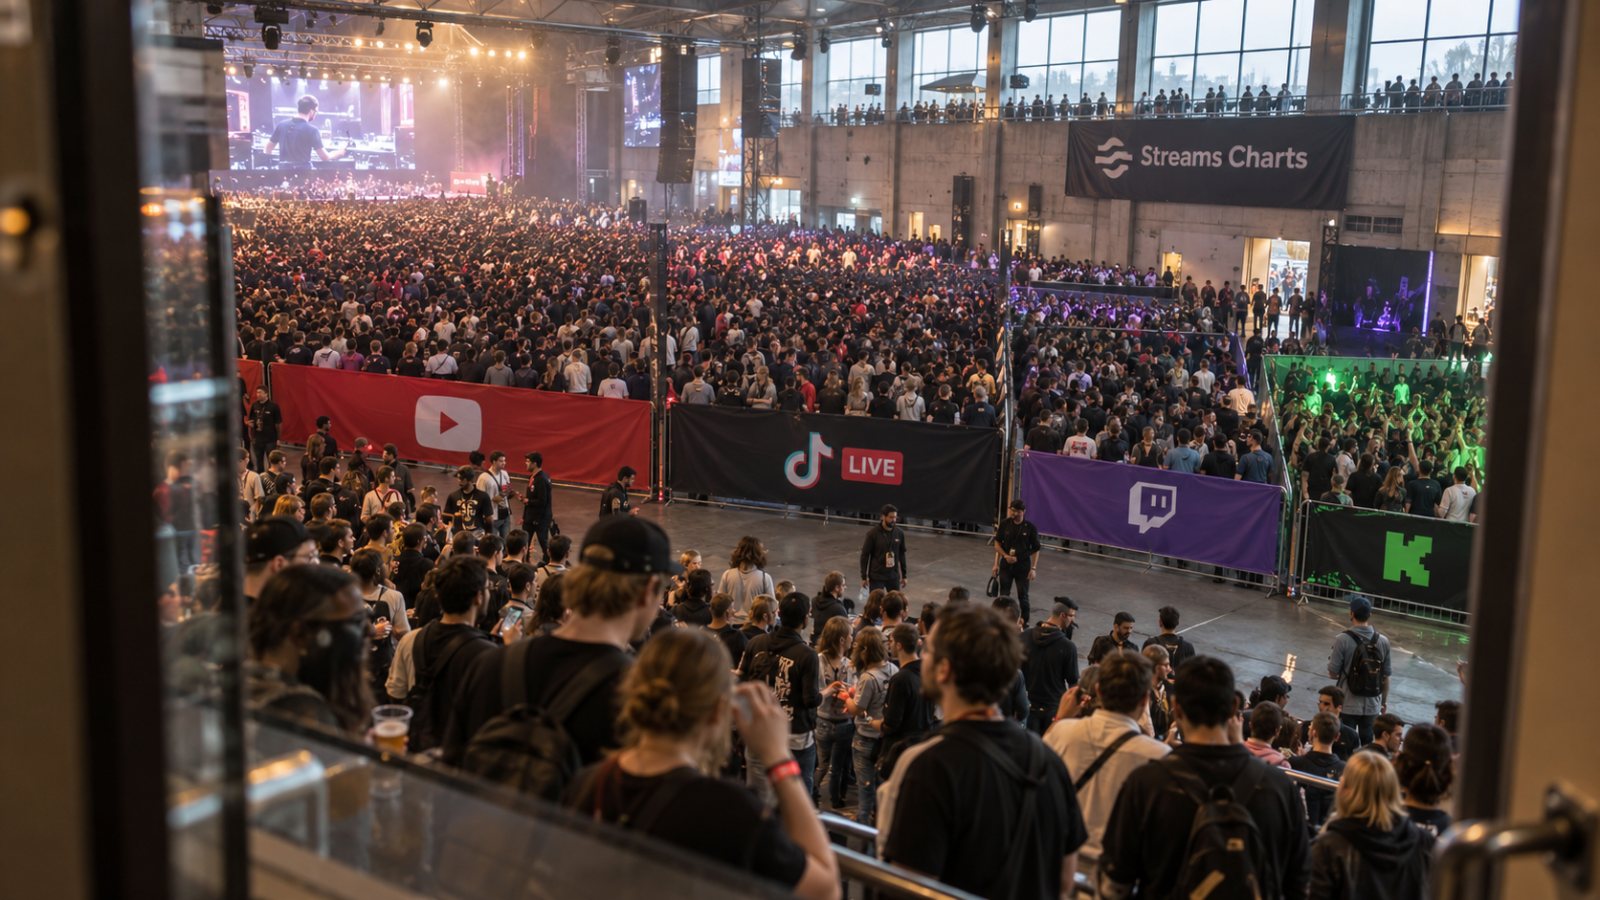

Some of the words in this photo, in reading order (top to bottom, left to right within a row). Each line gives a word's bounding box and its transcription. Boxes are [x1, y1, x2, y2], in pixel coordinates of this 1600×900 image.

[1141, 145, 1222, 167] Streams
[1228, 145, 1308, 169] Charts
[849, 455, 896, 478] LIVE
[1383, 530, 1433, 588] K
